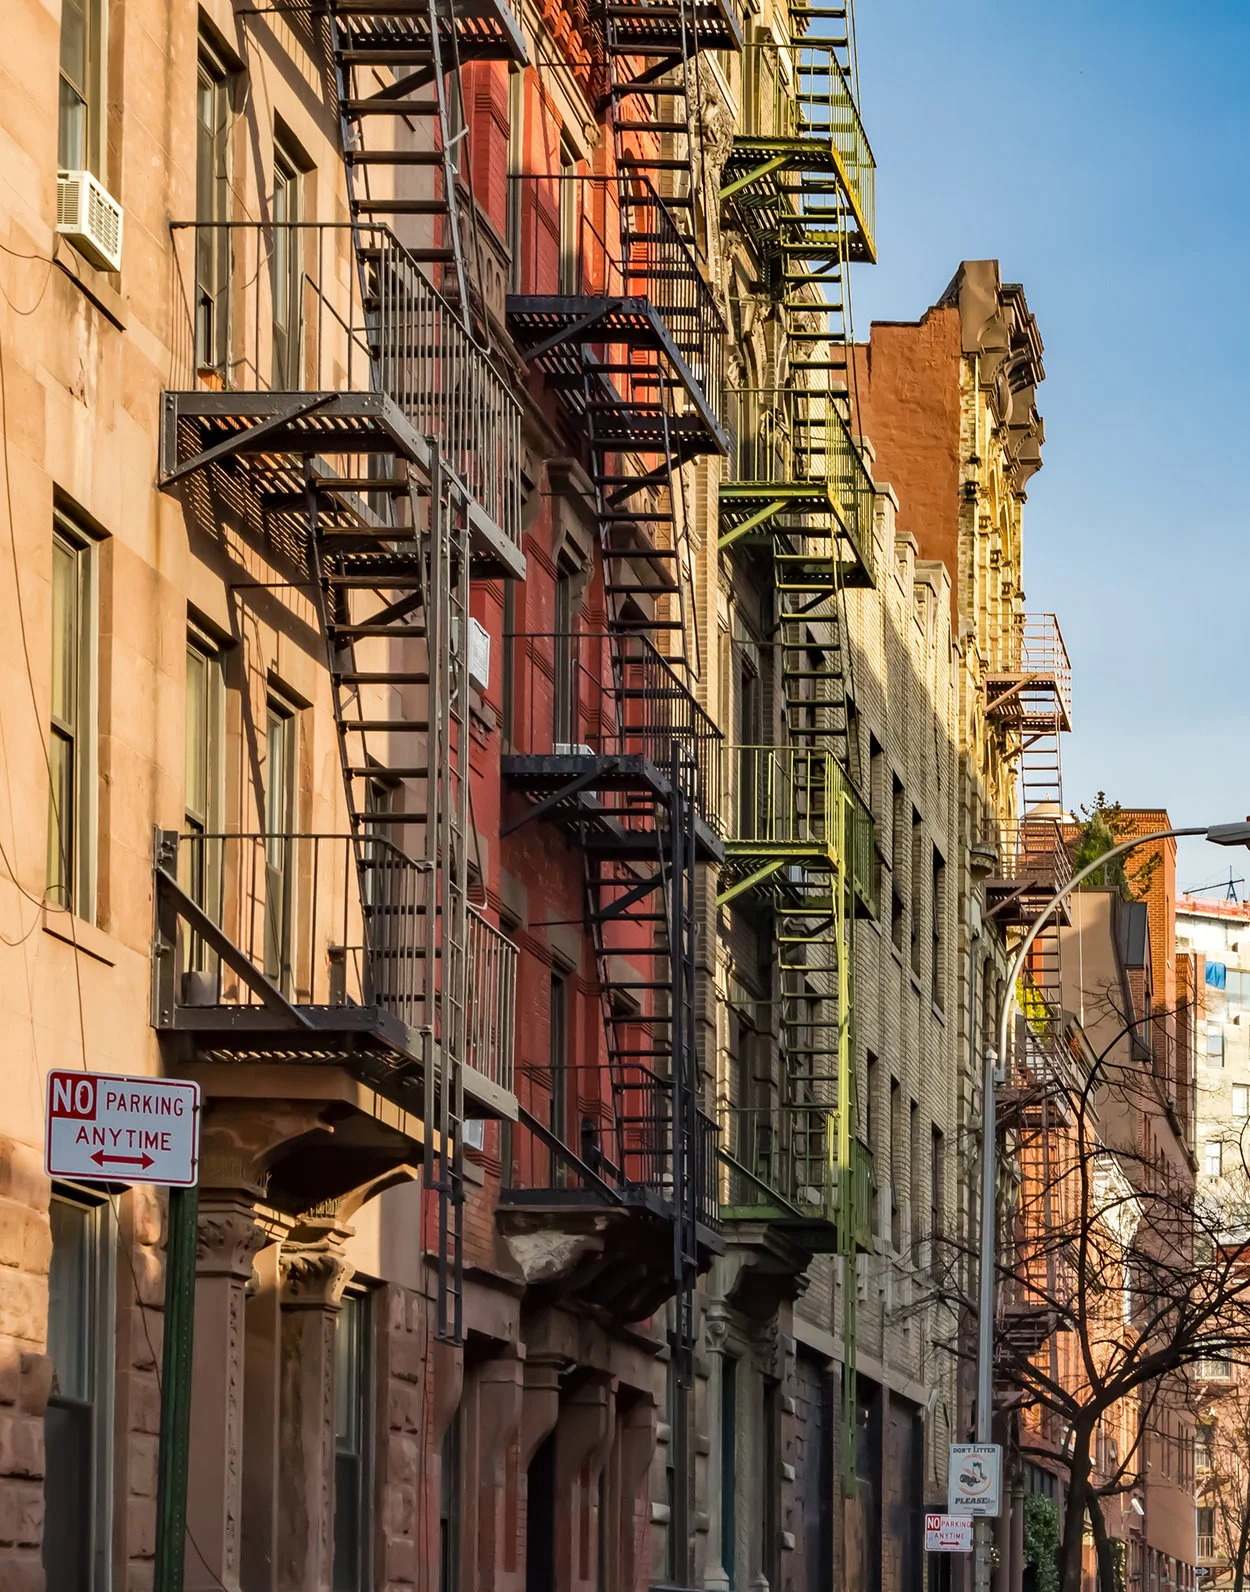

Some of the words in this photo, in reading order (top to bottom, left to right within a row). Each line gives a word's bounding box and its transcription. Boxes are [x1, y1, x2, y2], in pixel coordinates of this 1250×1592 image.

[53, 1078, 94, 1114] NO
[106, 1092, 183, 1117] PARKING
[75, 1126, 172, 1151] ANYTIME
[927, 1517, 940, 1529] NO
